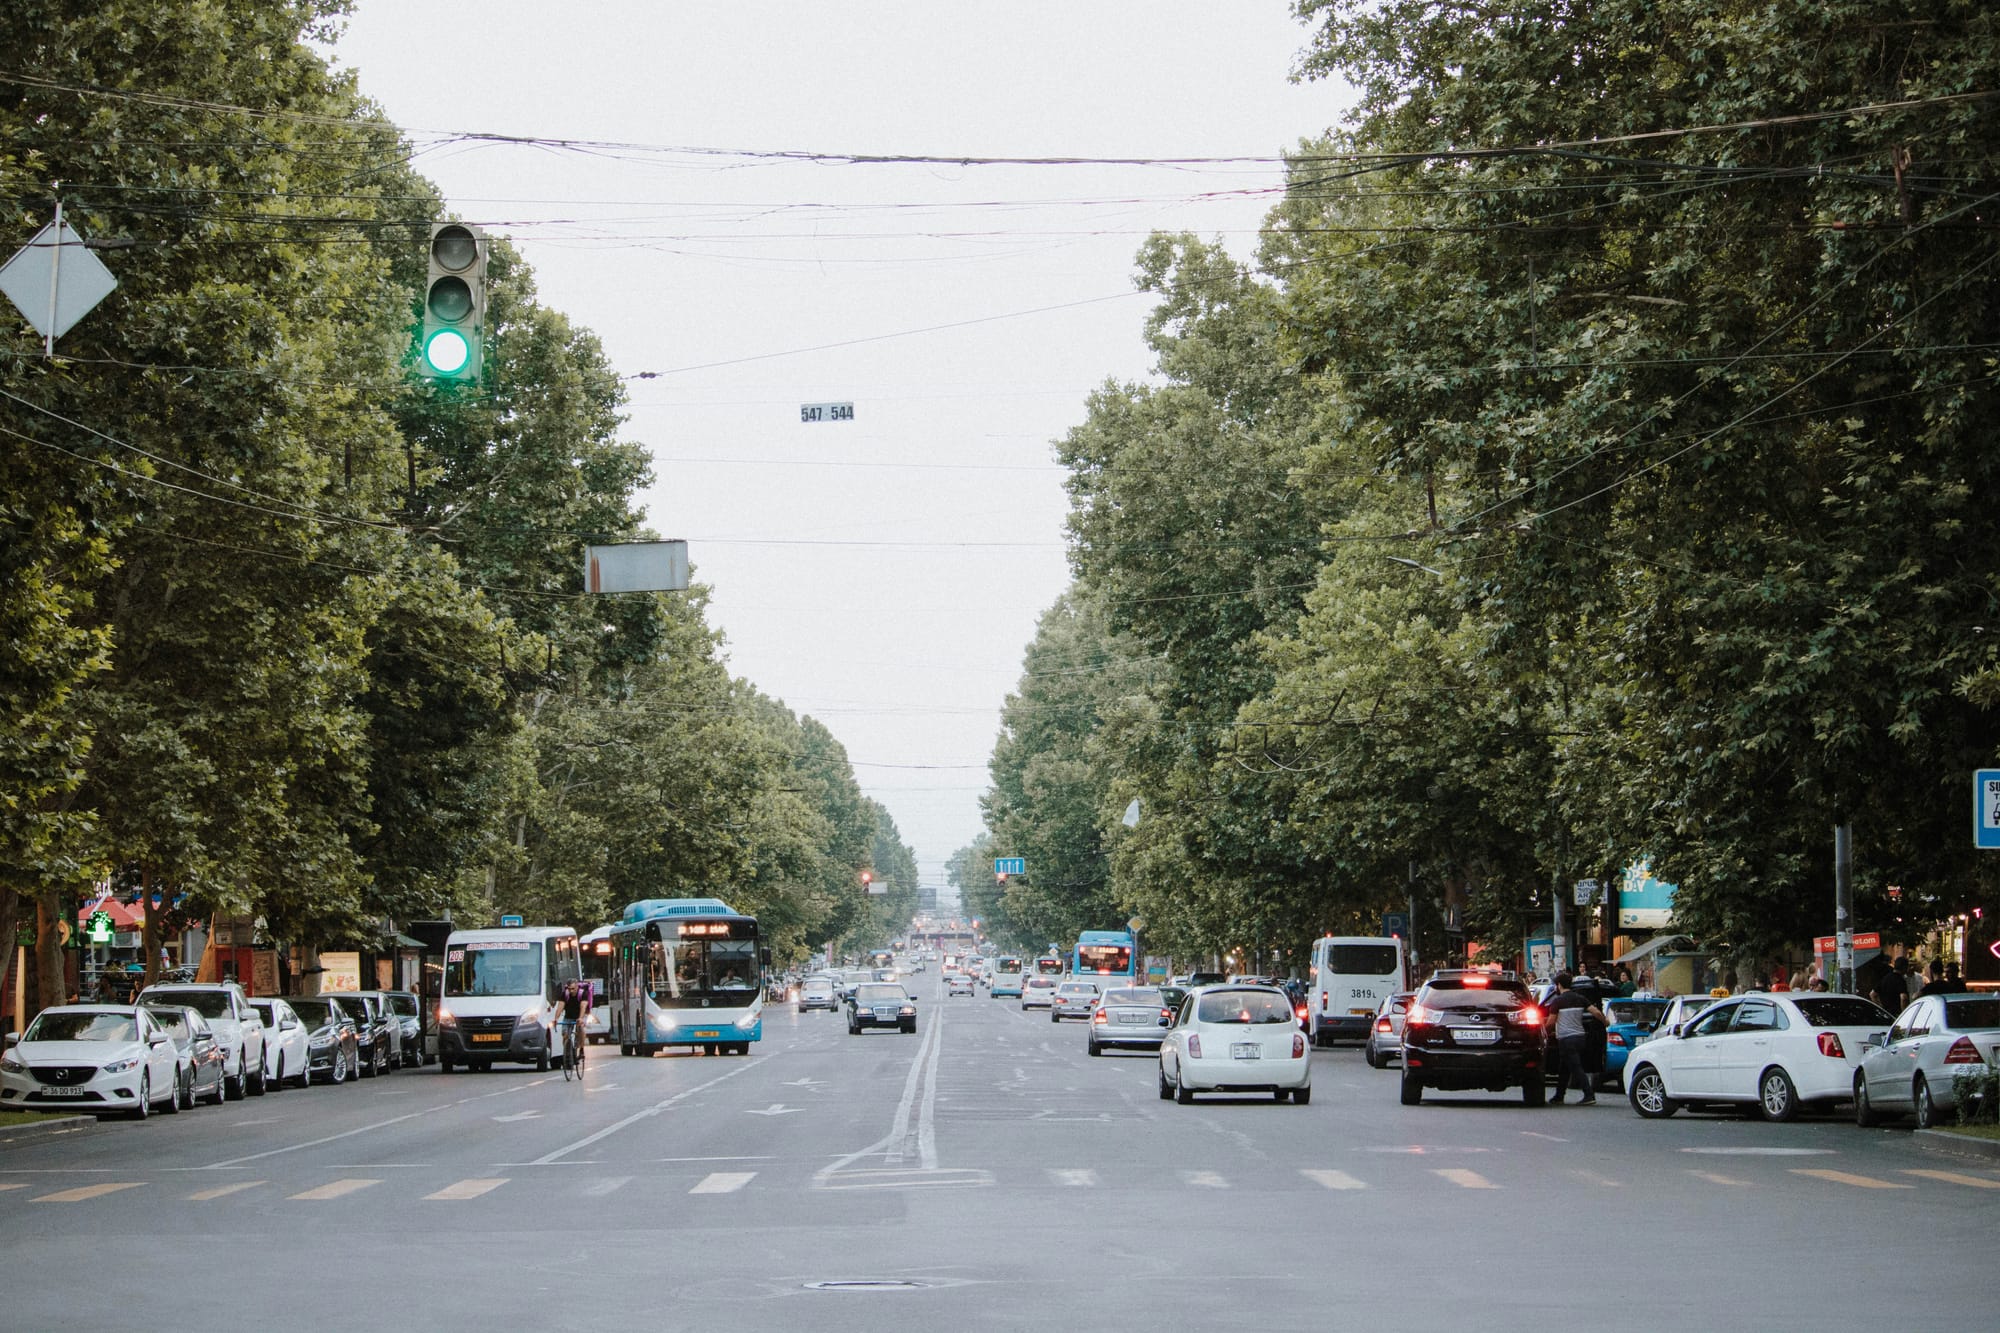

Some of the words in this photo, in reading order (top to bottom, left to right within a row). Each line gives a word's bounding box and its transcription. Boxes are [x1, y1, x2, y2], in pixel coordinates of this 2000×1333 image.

[801, 407, 822, 422] 547
[831, 406, 854, 420] 544
[449, 951, 464, 961] 203
[1351, 989, 1371, 998] 3819
